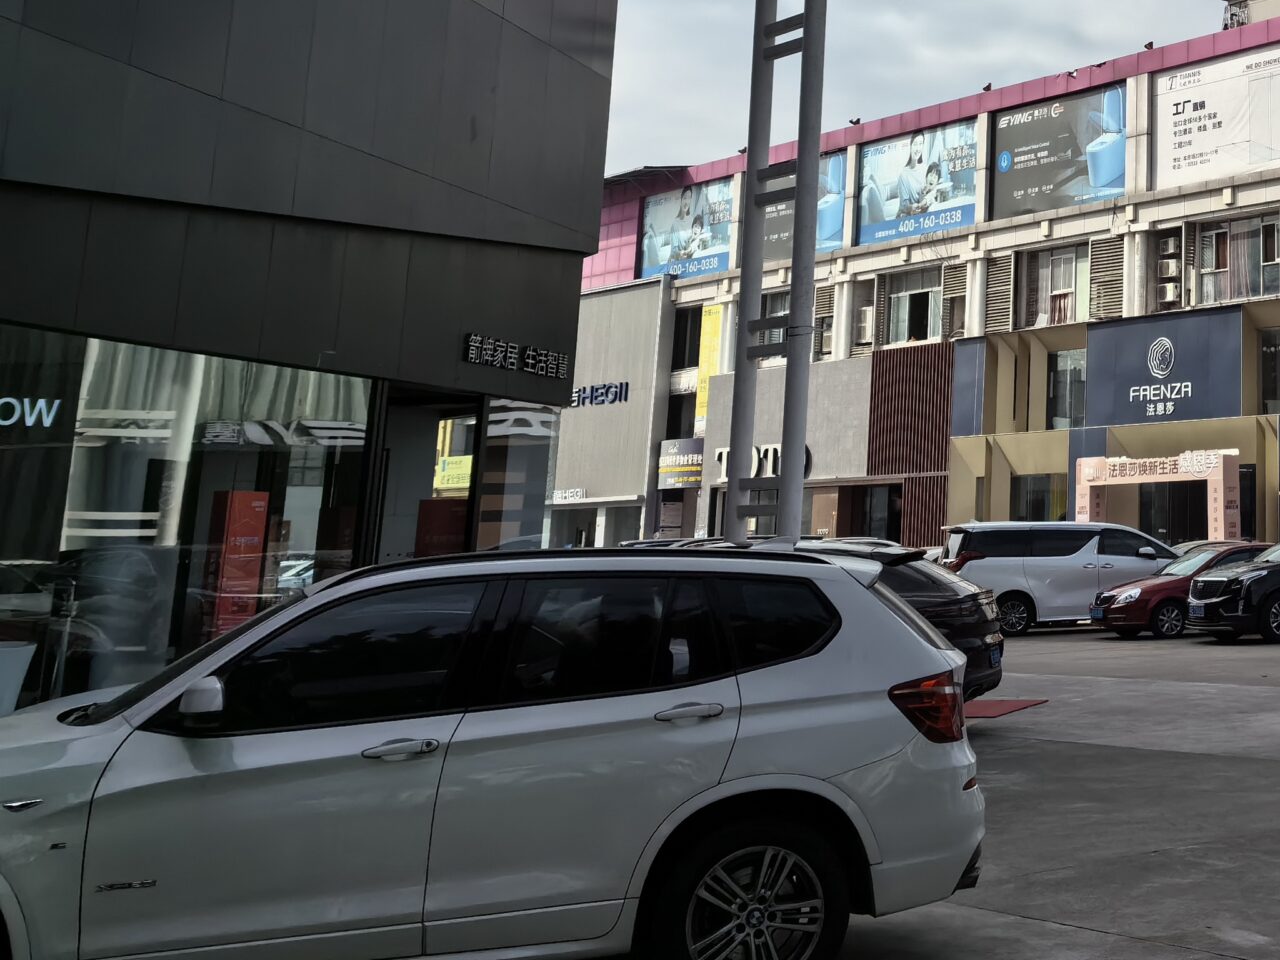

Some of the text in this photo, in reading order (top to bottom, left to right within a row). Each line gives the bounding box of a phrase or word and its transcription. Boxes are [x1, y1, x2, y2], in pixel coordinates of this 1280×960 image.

[898, 210, 962, 233] 400-160-0338
[669, 257, 718, 275] 400-160-0338
[468, 333, 568, 379] 箭牌家居 生活智慧
[1129, 382, 1192, 402] FAENZA
[1146, 401, 1175, 416] 法恩莎
[1108, 459, 1179, 479] 法恩莎焕新生活
